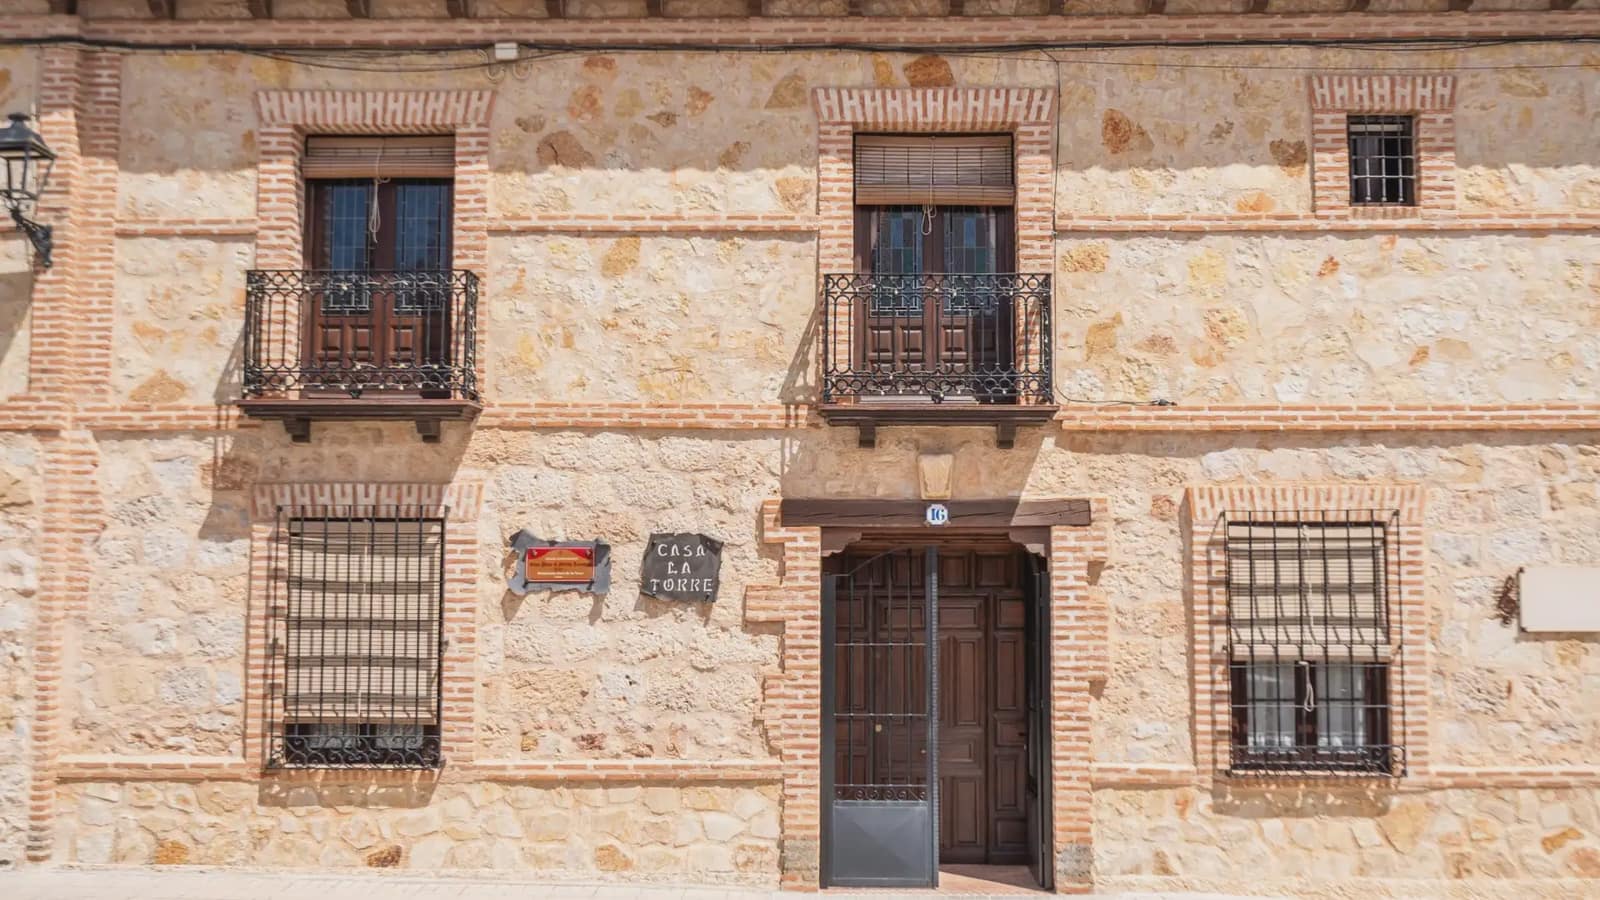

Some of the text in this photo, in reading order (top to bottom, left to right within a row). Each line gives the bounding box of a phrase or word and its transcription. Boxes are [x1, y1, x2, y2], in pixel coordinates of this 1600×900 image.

[931, 508, 945, 521] 16
[657, 543, 706, 557] CASA
[667, 561, 691, 574] LA
[650, 578, 713, 592] TORRE
